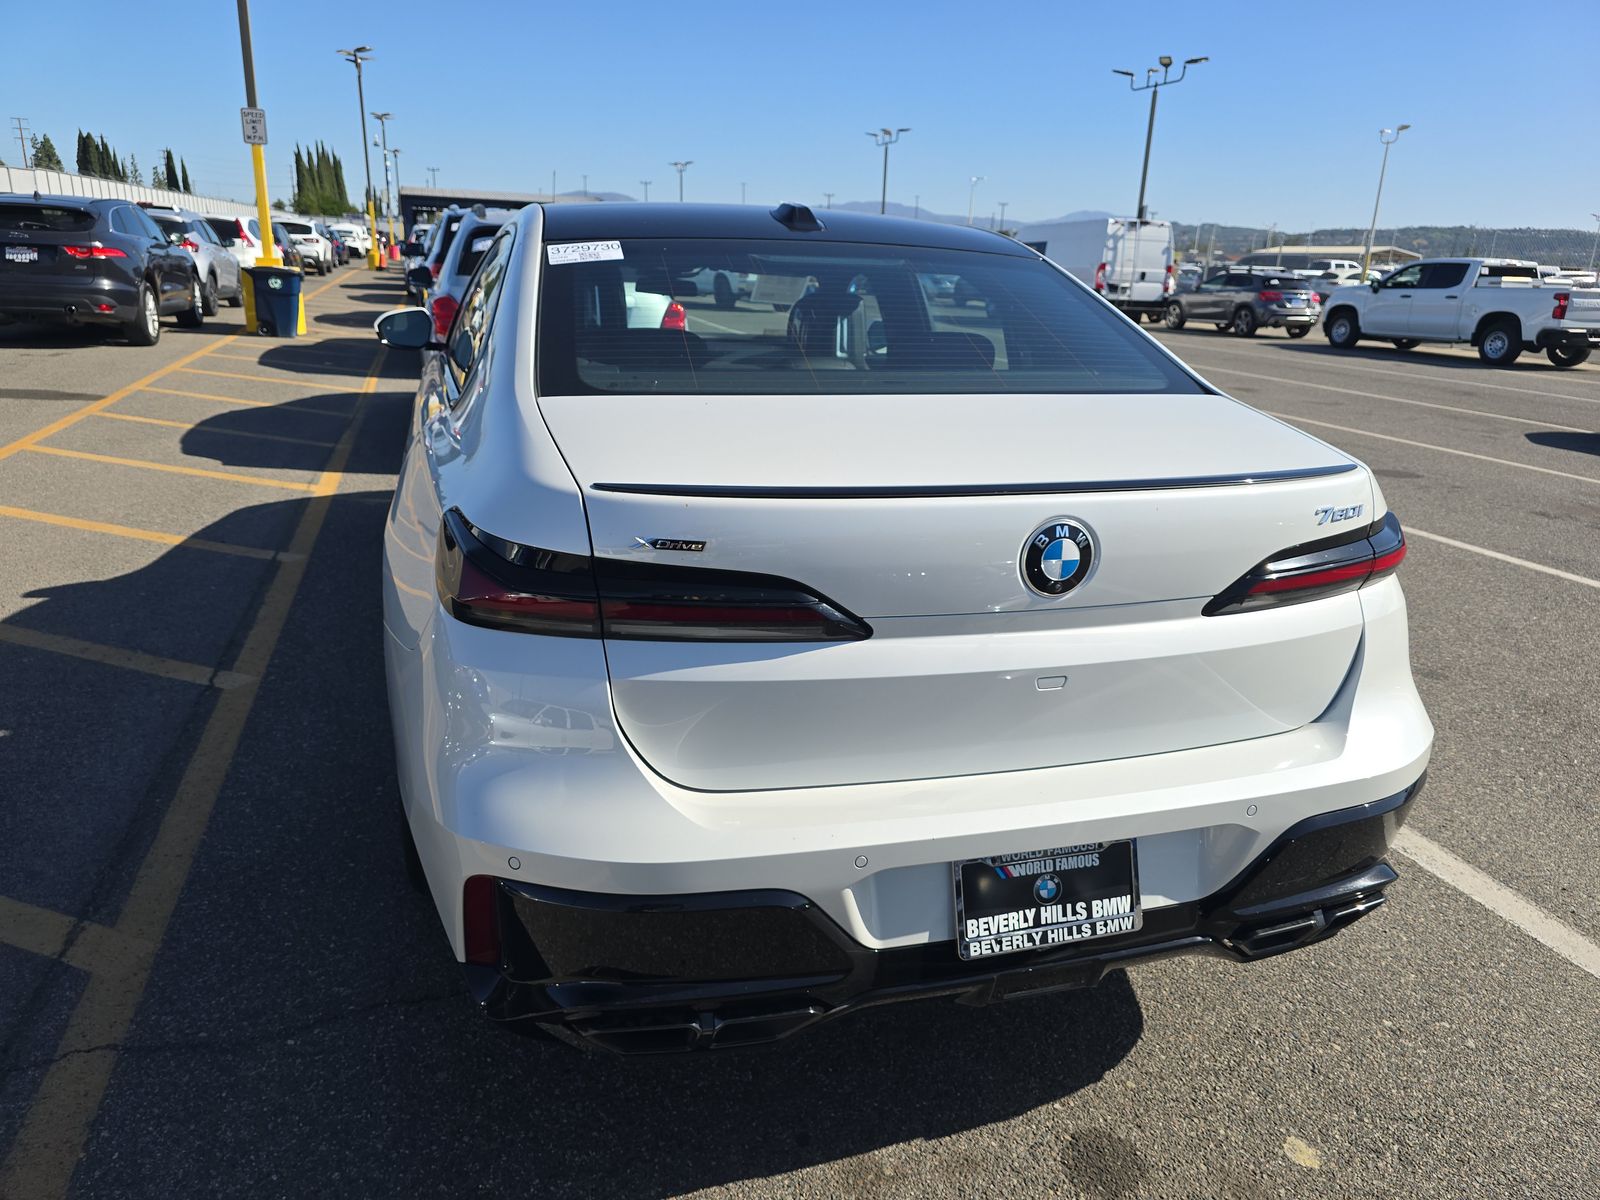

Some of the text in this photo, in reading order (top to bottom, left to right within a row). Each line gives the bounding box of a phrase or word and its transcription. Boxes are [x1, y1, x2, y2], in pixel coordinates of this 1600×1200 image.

[243, 111, 264, 119] SPEED
[252, 125, 258, 134] 5
[551, 243, 620, 255] 3729730
[1034, 525, 1089, 549] BMW
[1007, 853, 1100, 878] WORLD FAMOUS
[966, 895, 1131, 939] BEVERLY HILLS BMW
[970, 916, 1133, 956] BEVERLY HILLS BMW
